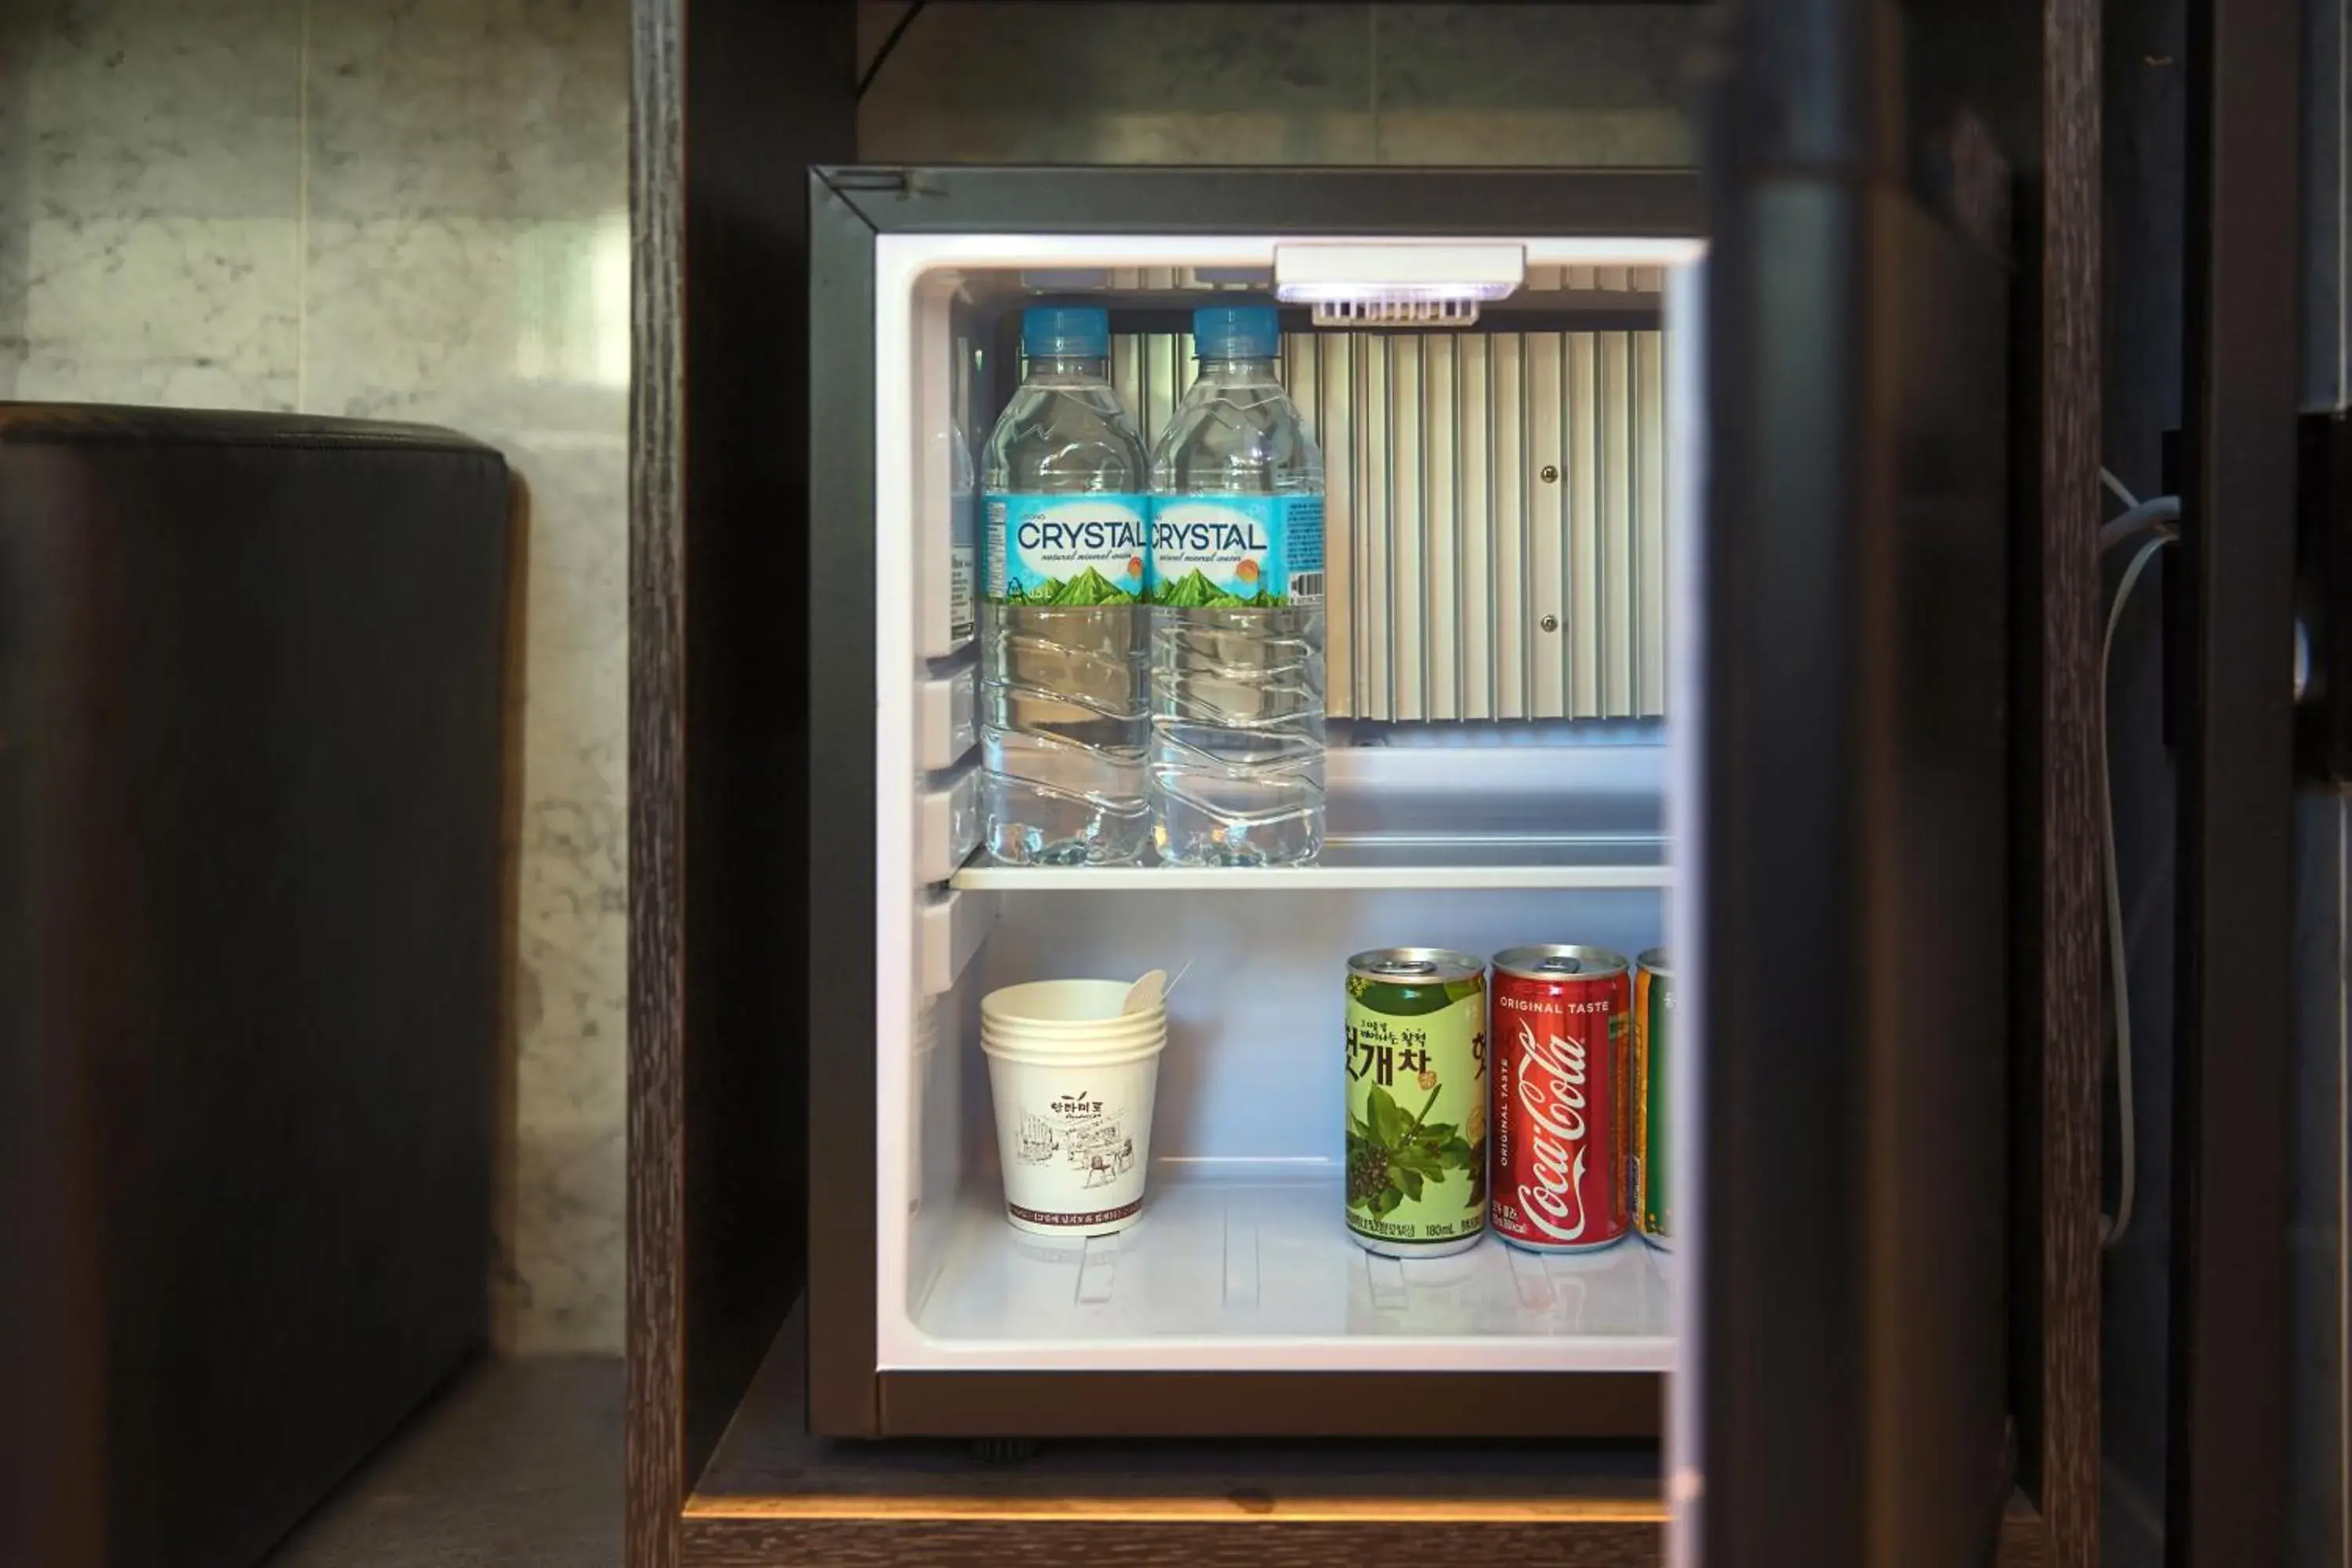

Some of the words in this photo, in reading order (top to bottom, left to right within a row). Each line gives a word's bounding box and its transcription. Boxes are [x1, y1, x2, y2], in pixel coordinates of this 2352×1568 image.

[1018, 521, 1147, 550] CRYSTAL
[1500, 996, 1563, 1014] ORIGINAL
[1567, 1001, 1610, 1014] TASTE
[1518, 1017, 1587, 1240] Coca-Cola
